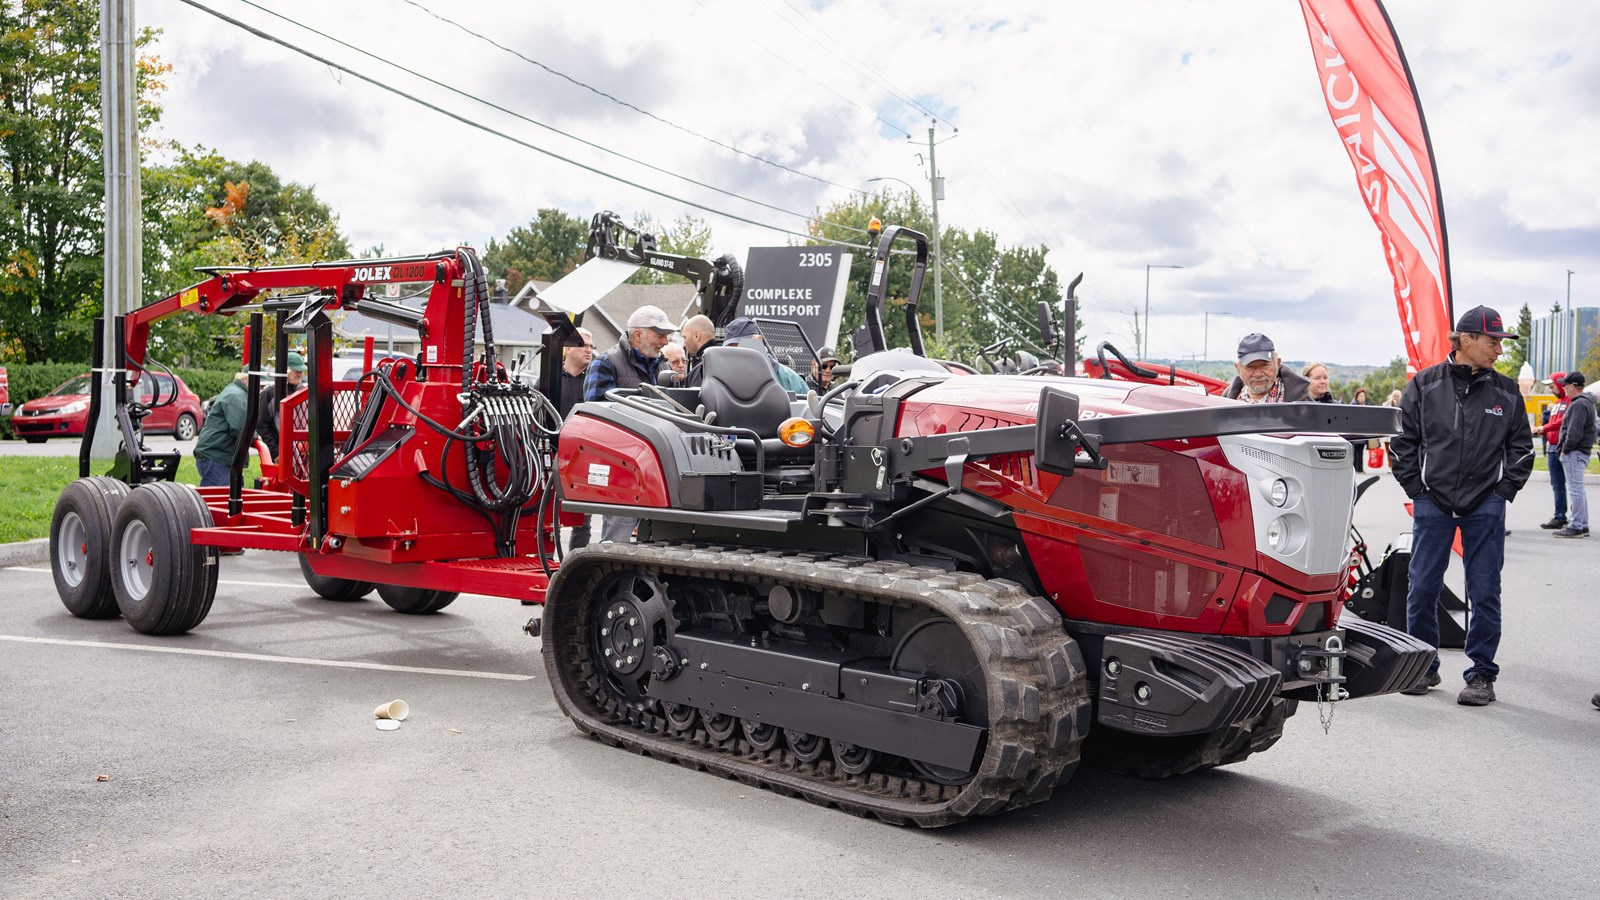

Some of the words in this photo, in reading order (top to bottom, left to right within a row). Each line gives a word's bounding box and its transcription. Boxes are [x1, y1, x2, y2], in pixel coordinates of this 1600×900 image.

[799, 253, 833, 267] 2305
[351, 266, 392, 282] JOLEX
[747, 288, 812, 300] COMPLEXE
[744, 304, 821, 316] MULTISPORT
